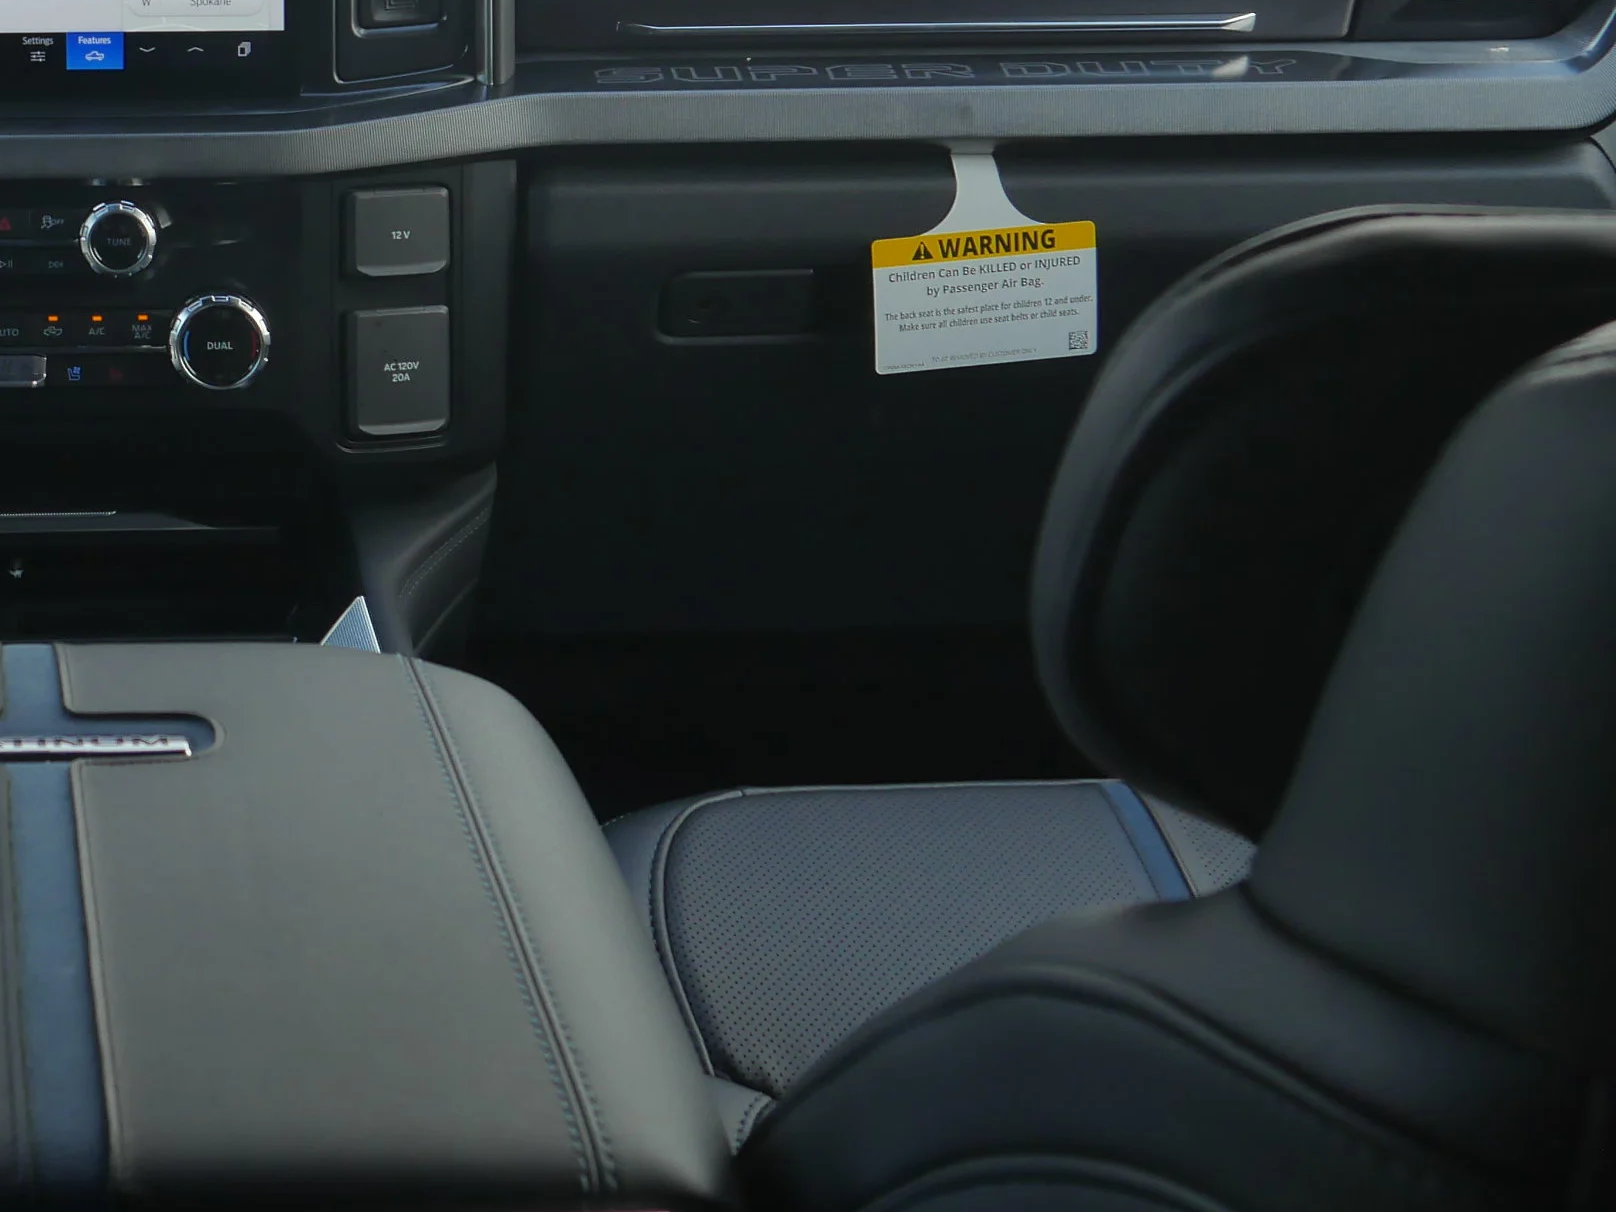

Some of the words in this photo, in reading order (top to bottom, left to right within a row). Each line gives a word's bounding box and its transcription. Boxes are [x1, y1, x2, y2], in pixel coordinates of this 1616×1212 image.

[22, 36, 54, 47] Settings
[78, 36, 111, 45] Features
[593, 63, 975, 84] SUPER
[1000, 59, 1296, 78] DUTY
[391, 231, 402, 240] 12
[403, 231, 410, 239] V
[107, 238, 132, 246] TUNE
[938, 229, 1056, 258] WARNING
[889, 271, 935, 283] Children
[939, 268, 959, 278] Can
[963, 266, 975, 276] Be
[980, 262, 1017, 274] KILLED
[1020, 262, 1032, 270] or
[1035, 256, 1080, 269] INJURED
[927, 286, 940, 297] by
[943, 281, 998, 294] Passenger
[1002, 279, 1017, 288] Air
[1021, 277, 1044, 288] Bag.
[885, 313, 898, 321] The
[901, 311, 916, 320] back
[919, 310, 933, 318] seat
[957, 305, 979, 314] safest
[981, 303, 999, 314] place
[1013, 299, 1042, 308] children
[1055, 296, 1068, 305] and
[1070, 294, 1093, 303] under.
[899, 323, 919, 332] Make
[921, 322, 936, 330] sure
[939, 320, 947, 328] all
[949, 317, 978, 327] children
[994, 315, 1009, 323] seat
[1011, 313, 1028, 321] belts
[1040, 309, 1057, 318] child
[1059, 308, 1080, 316] seats.
[88, 328, 105, 336] A/C
[132, 324, 152, 332] MAX
[207, 341, 233, 350] DUAL
[384, 363, 397, 371] AC
[398, 361, 420, 370] 120V
[392, 373, 410, 382] 20A
